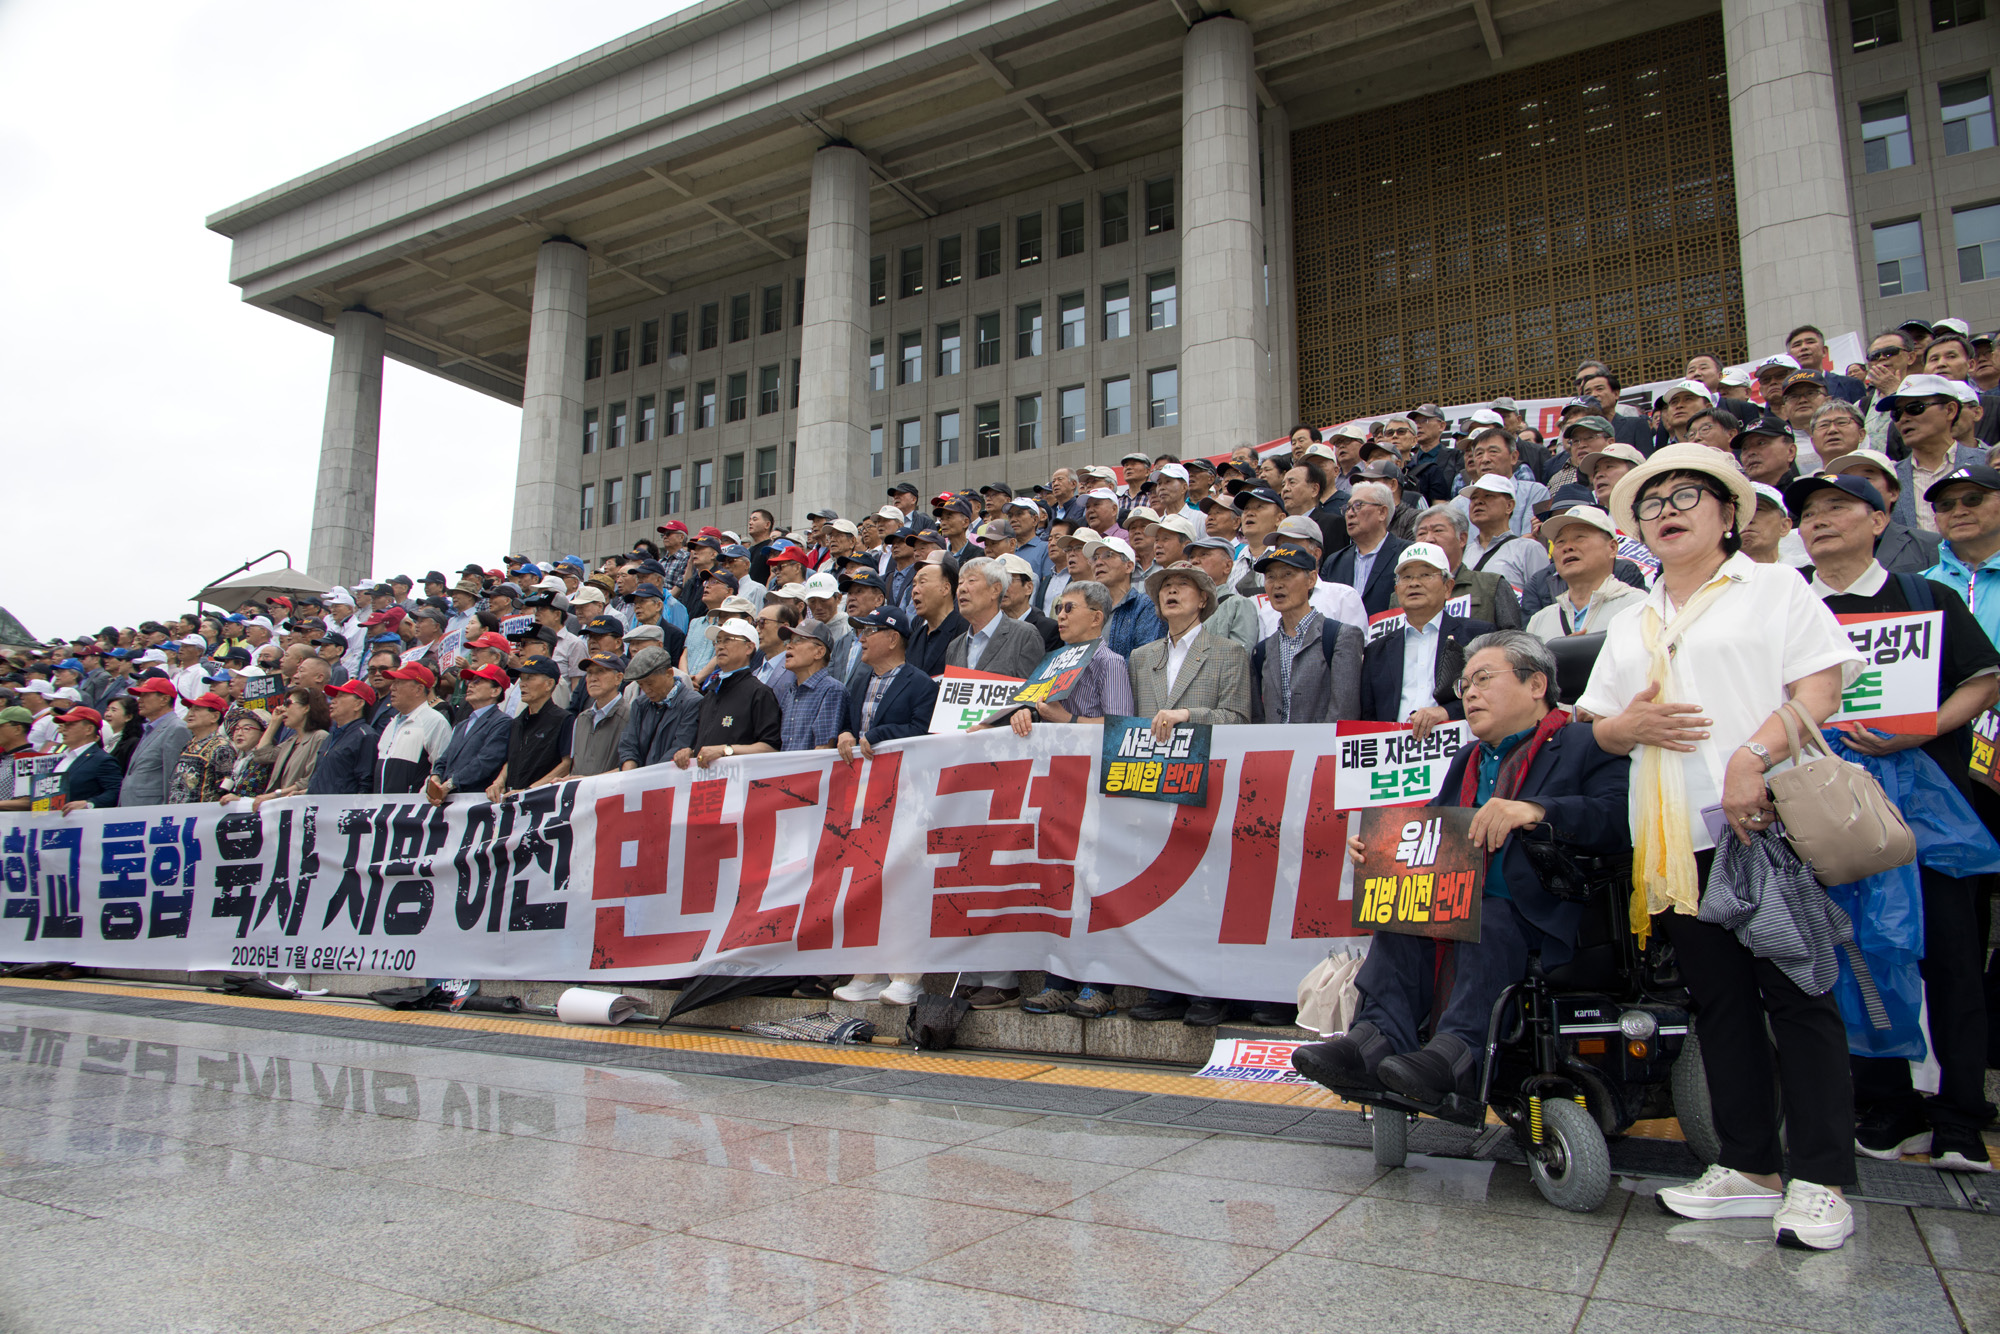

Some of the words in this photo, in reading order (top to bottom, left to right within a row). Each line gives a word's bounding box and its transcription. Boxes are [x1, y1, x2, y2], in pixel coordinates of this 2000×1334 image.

[1406, 547, 1428, 557] KMA
[942, 682, 975, 705] 태릉
[1840, 670, 1883, 713] 존
[1972, 709, 2000, 742] 사
[1117, 727, 1195, 758] 사관학교
[1341, 738, 1378, 769] 태릉
[1384, 727, 1461, 765] 자연환경
[1969, 736, 1996, 775] 전
[1105, 761, 1163, 793] 통폐합
[1162, 763, 1204, 793] 반대
[1369, 764, 1431, 801] 보전
[1395, 816, 1442, 868] 육사
[0, 827, 84, 942] 학교
[98, 816, 202, 941] 통합
[211, 806, 320, 940] 육사
[322, 802, 449, 937] 지방
[455, 781, 580, 933] 이전
[589, 750, 903, 970] 반대
[1358, 875, 1398, 924] 지방
[1397, 872, 1435, 923] 이전
[1433, 869, 1476, 922] 반대
[231, 945, 279, 968] 2026년
[284, 945, 309, 969] 7월
[311, 946, 366, 972] 8일(수)
[370, 949, 417, 971] 11:00
[1574, 1009, 1600, 1018] karma
[1240, 1045, 1293, 1067] 중단
